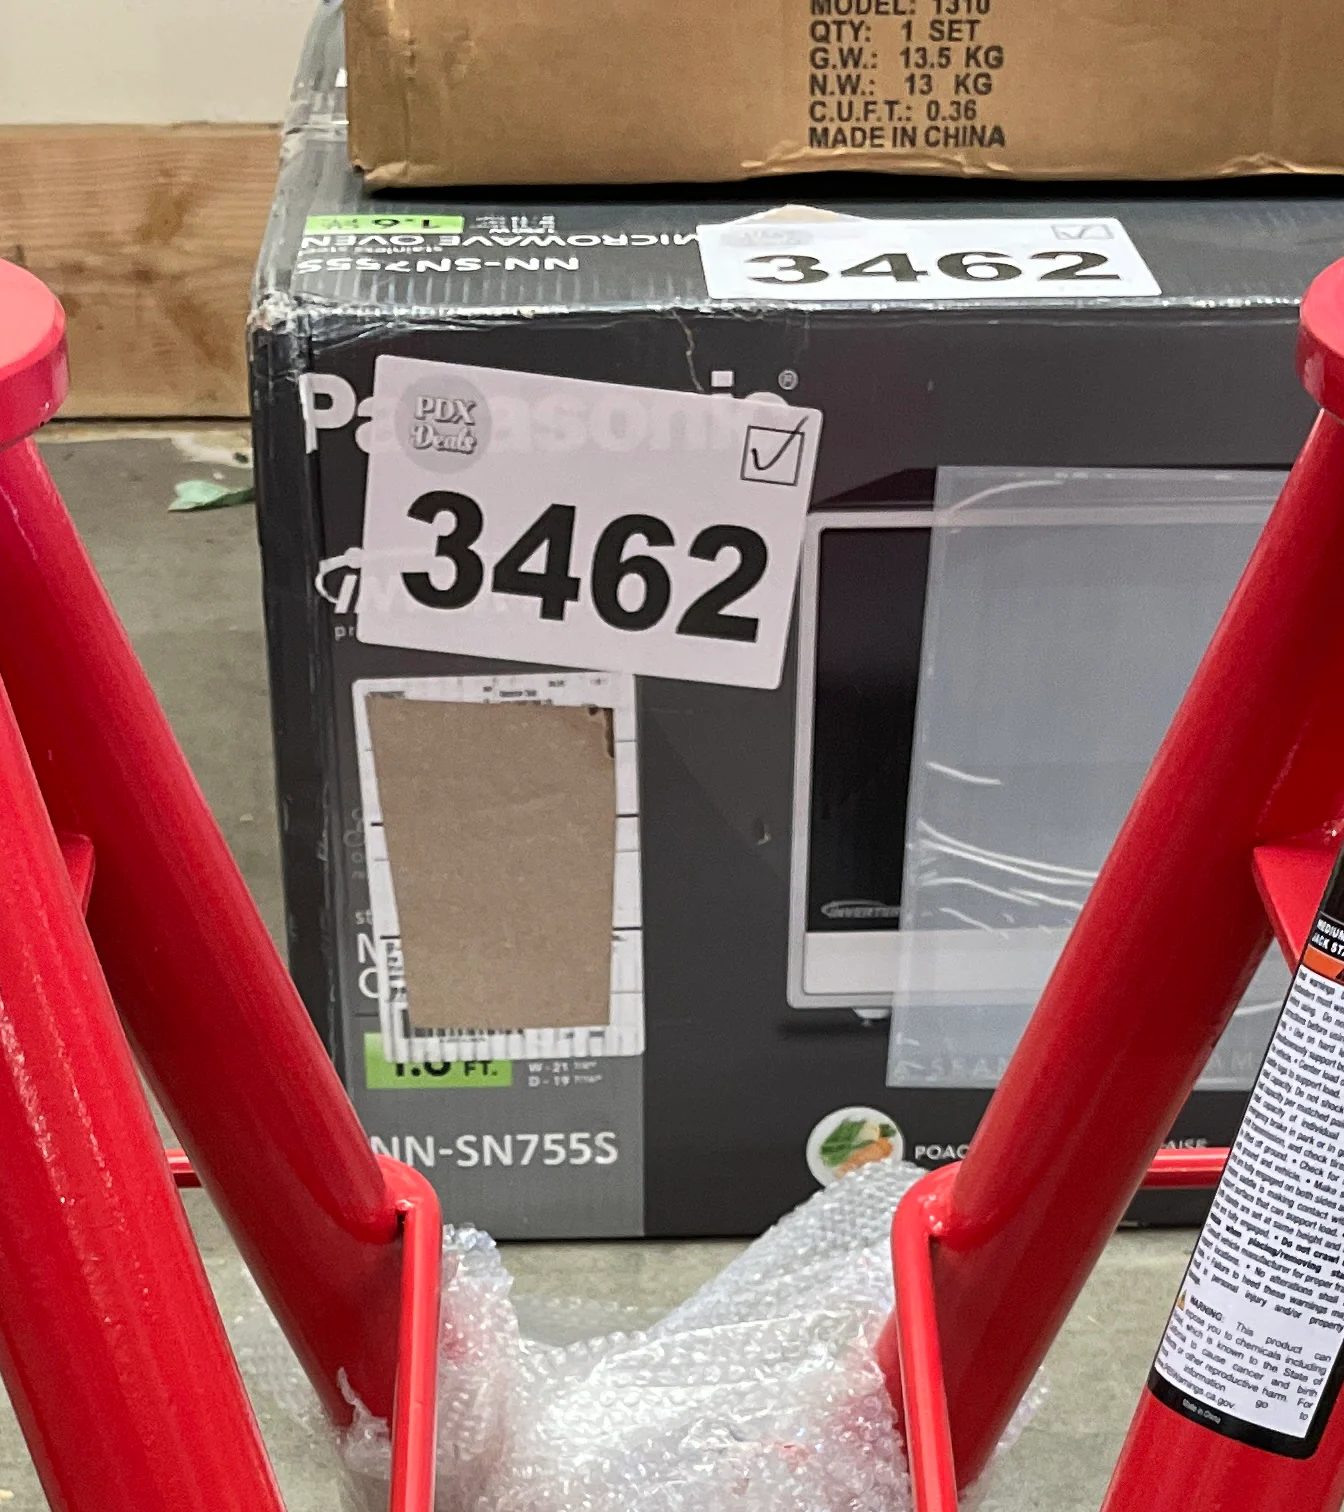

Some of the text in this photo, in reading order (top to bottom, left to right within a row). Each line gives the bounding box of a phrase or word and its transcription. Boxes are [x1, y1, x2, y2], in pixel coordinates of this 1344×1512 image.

[810, 0, 991, 16] MODEL: 1310
[810, 20, 981, 43] QTY: 1 SET
[809, 45, 1004, 70] G.W.: 13.5 KG
[809, 72, 992, 96] N.W.: 13 KG
[809, 100, 977, 122] C.U.F.T.: 0.36
[809, 125, 1006, 148] MADE IN CHINA
[301, 234, 698, 248] MICROWAVE OVEN
[297, 256, 581, 274] NN-SN755S
[747, 250, 1122, 285] 3462
[413, 395, 478, 427] PDX
[409, 424, 478, 455] Deals
[402, 490, 769, 644] 3462
[370, 1130, 619, 1168] NN-SN755S
[914, 1144, 969, 1161] POAC
[1308, 1316, 1344, 1334] property
[1235, 1320, 1254, 1337] This
[1264, 1336, 1303, 1355] product
[1313, 1352, 1332, 1363] can
[1216, 1340, 1324, 1386] known to the State of
[1235, 1337, 1282, 1361] chemicals
[1284, 1356, 1328, 1377] including
[1203, 1363, 1314, 1409] reproductive harm. For
[1231, 1363, 1265, 1381] cancer
[1270, 1378, 1291, 1390] and
[1296, 1384, 1318, 1397] birth
[1255, 1399, 1269, 1409] go
[1298, 1411, 1309, 1421] to
